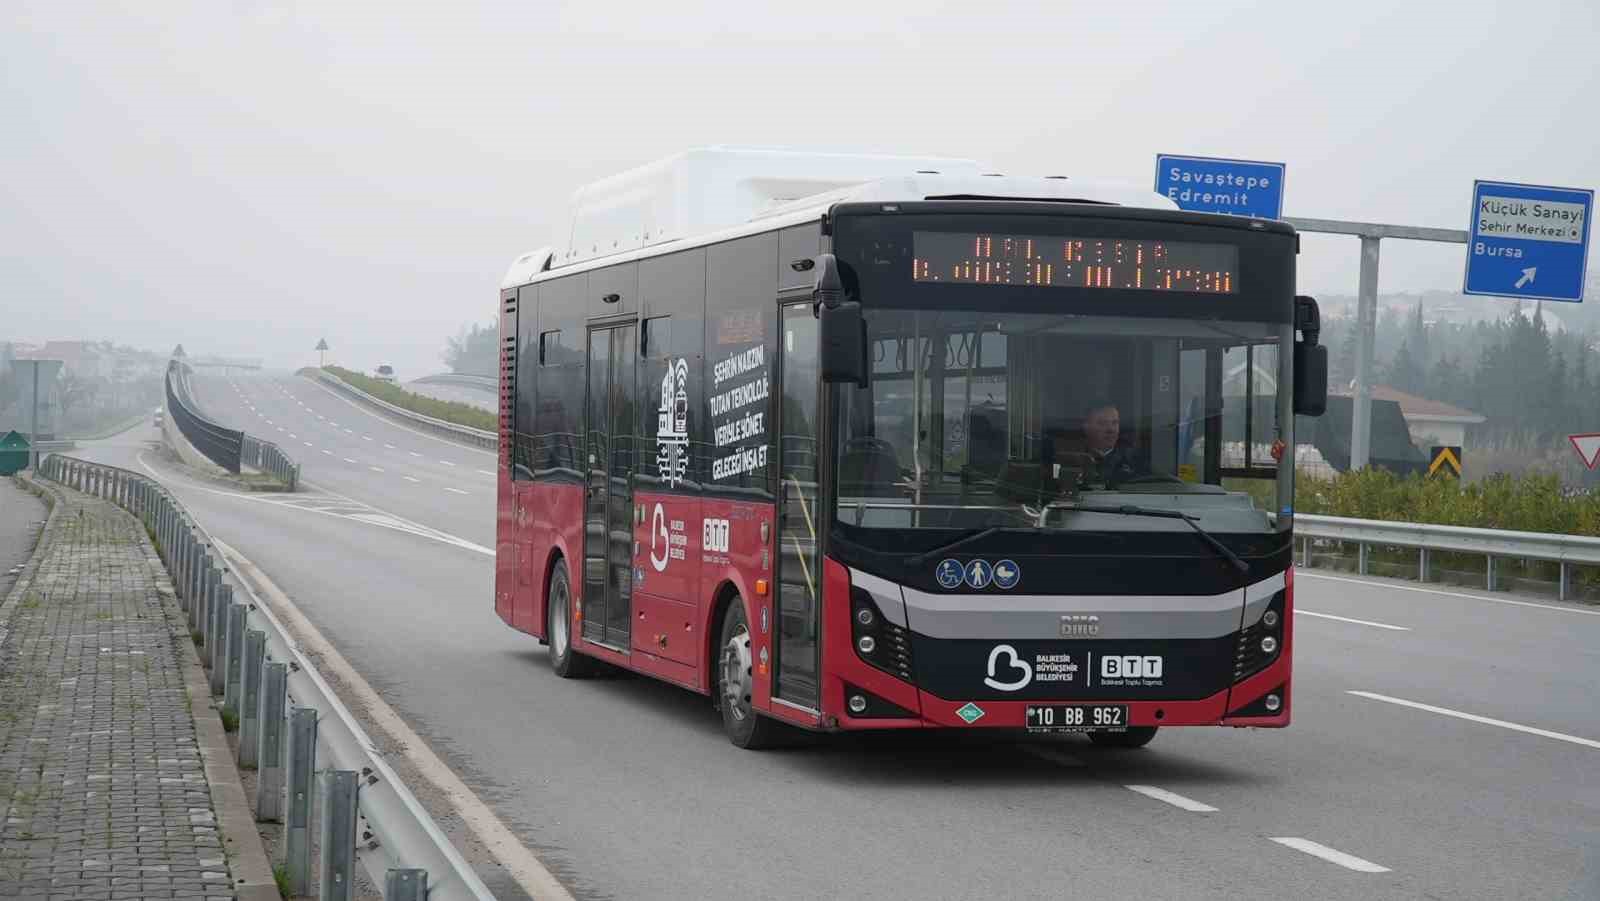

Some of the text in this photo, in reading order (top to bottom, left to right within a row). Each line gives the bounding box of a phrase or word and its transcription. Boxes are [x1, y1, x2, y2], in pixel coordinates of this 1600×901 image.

[1169, 167, 1270, 190] Savaştepe
[1168, 187, 1248, 206] Edremit
[1480, 200, 1584, 223] Küçük Sanayi
[1516, 223, 1566, 237] Merkezi
[1474, 242, 1523, 258] Bursa
[710, 391, 731, 417] TUTAN
[759, 445, 768, 467] ET
[705, 520, 729, 550] BTT
[1060, 615, 1099, 636] BMC
[1036, 653, 1071, 663] BALIKESİR
[1103, 657, 1161, 677] BTT
[1037, 707, 1121, 725] 10 BB 962
